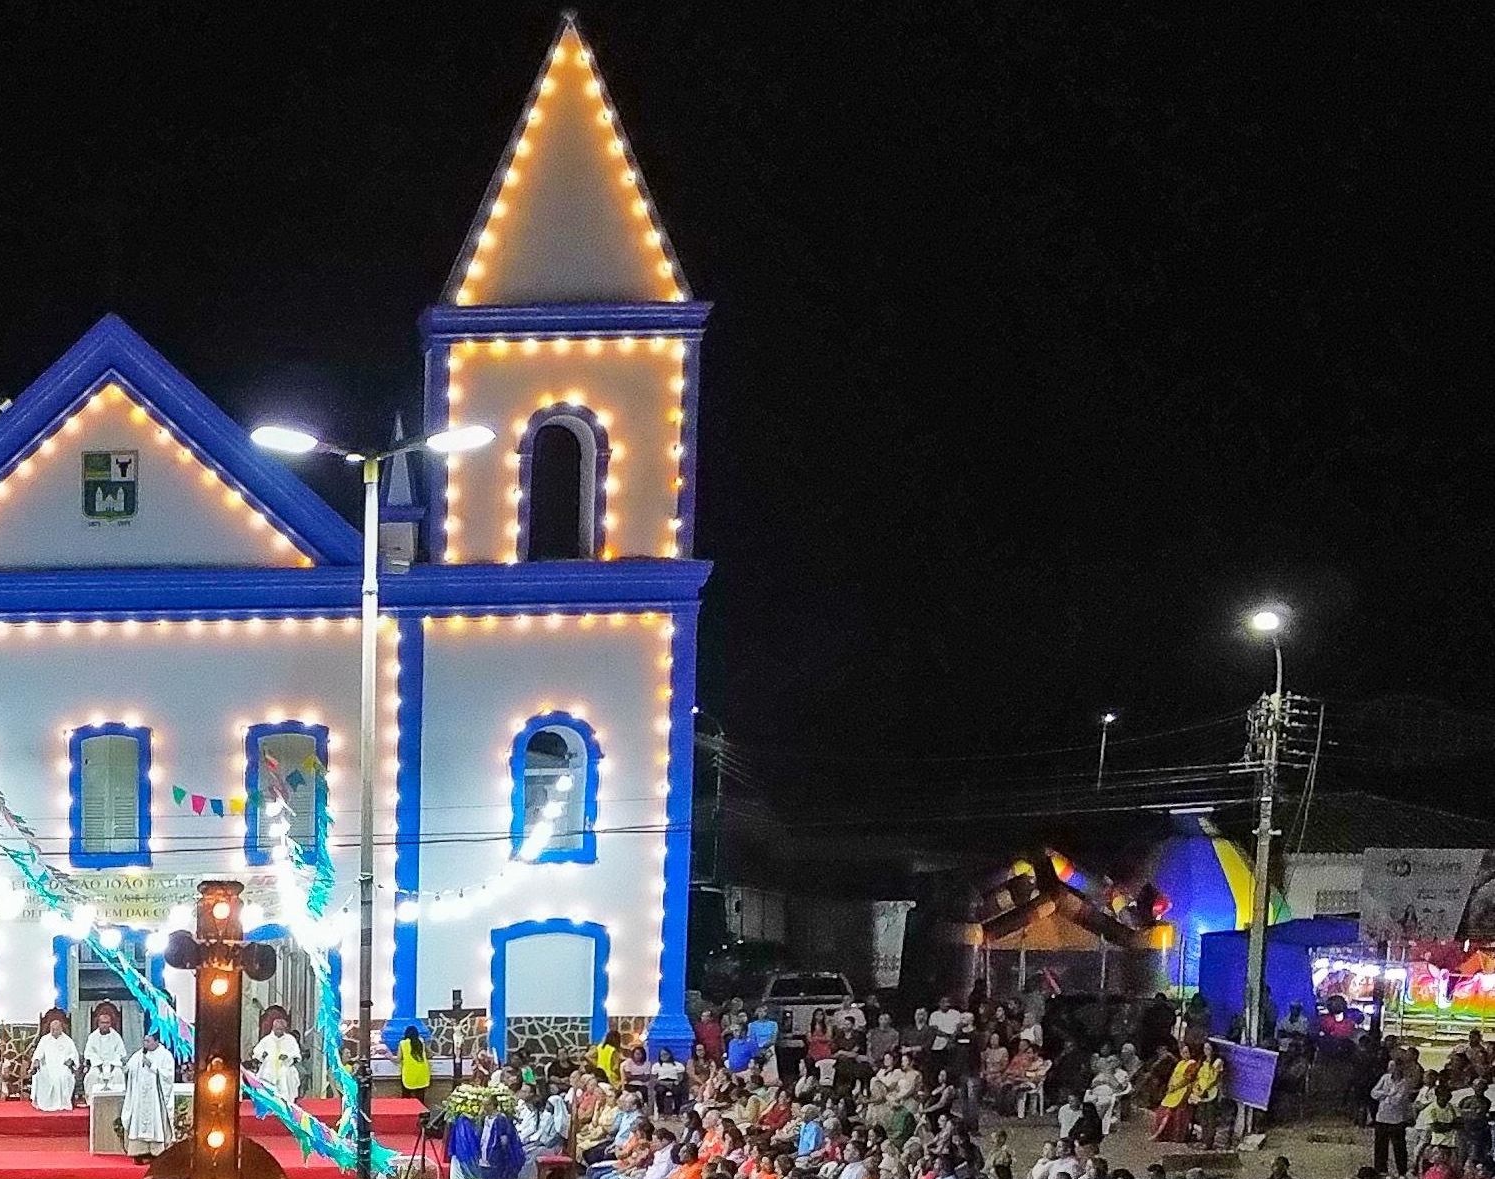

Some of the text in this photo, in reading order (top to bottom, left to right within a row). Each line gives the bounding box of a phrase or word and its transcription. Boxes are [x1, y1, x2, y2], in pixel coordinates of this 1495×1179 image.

[105, 876, 143, 890] JOÃO
[147, 878, 196, 890] BATIST
[126, 908, 150, 918] DAR
